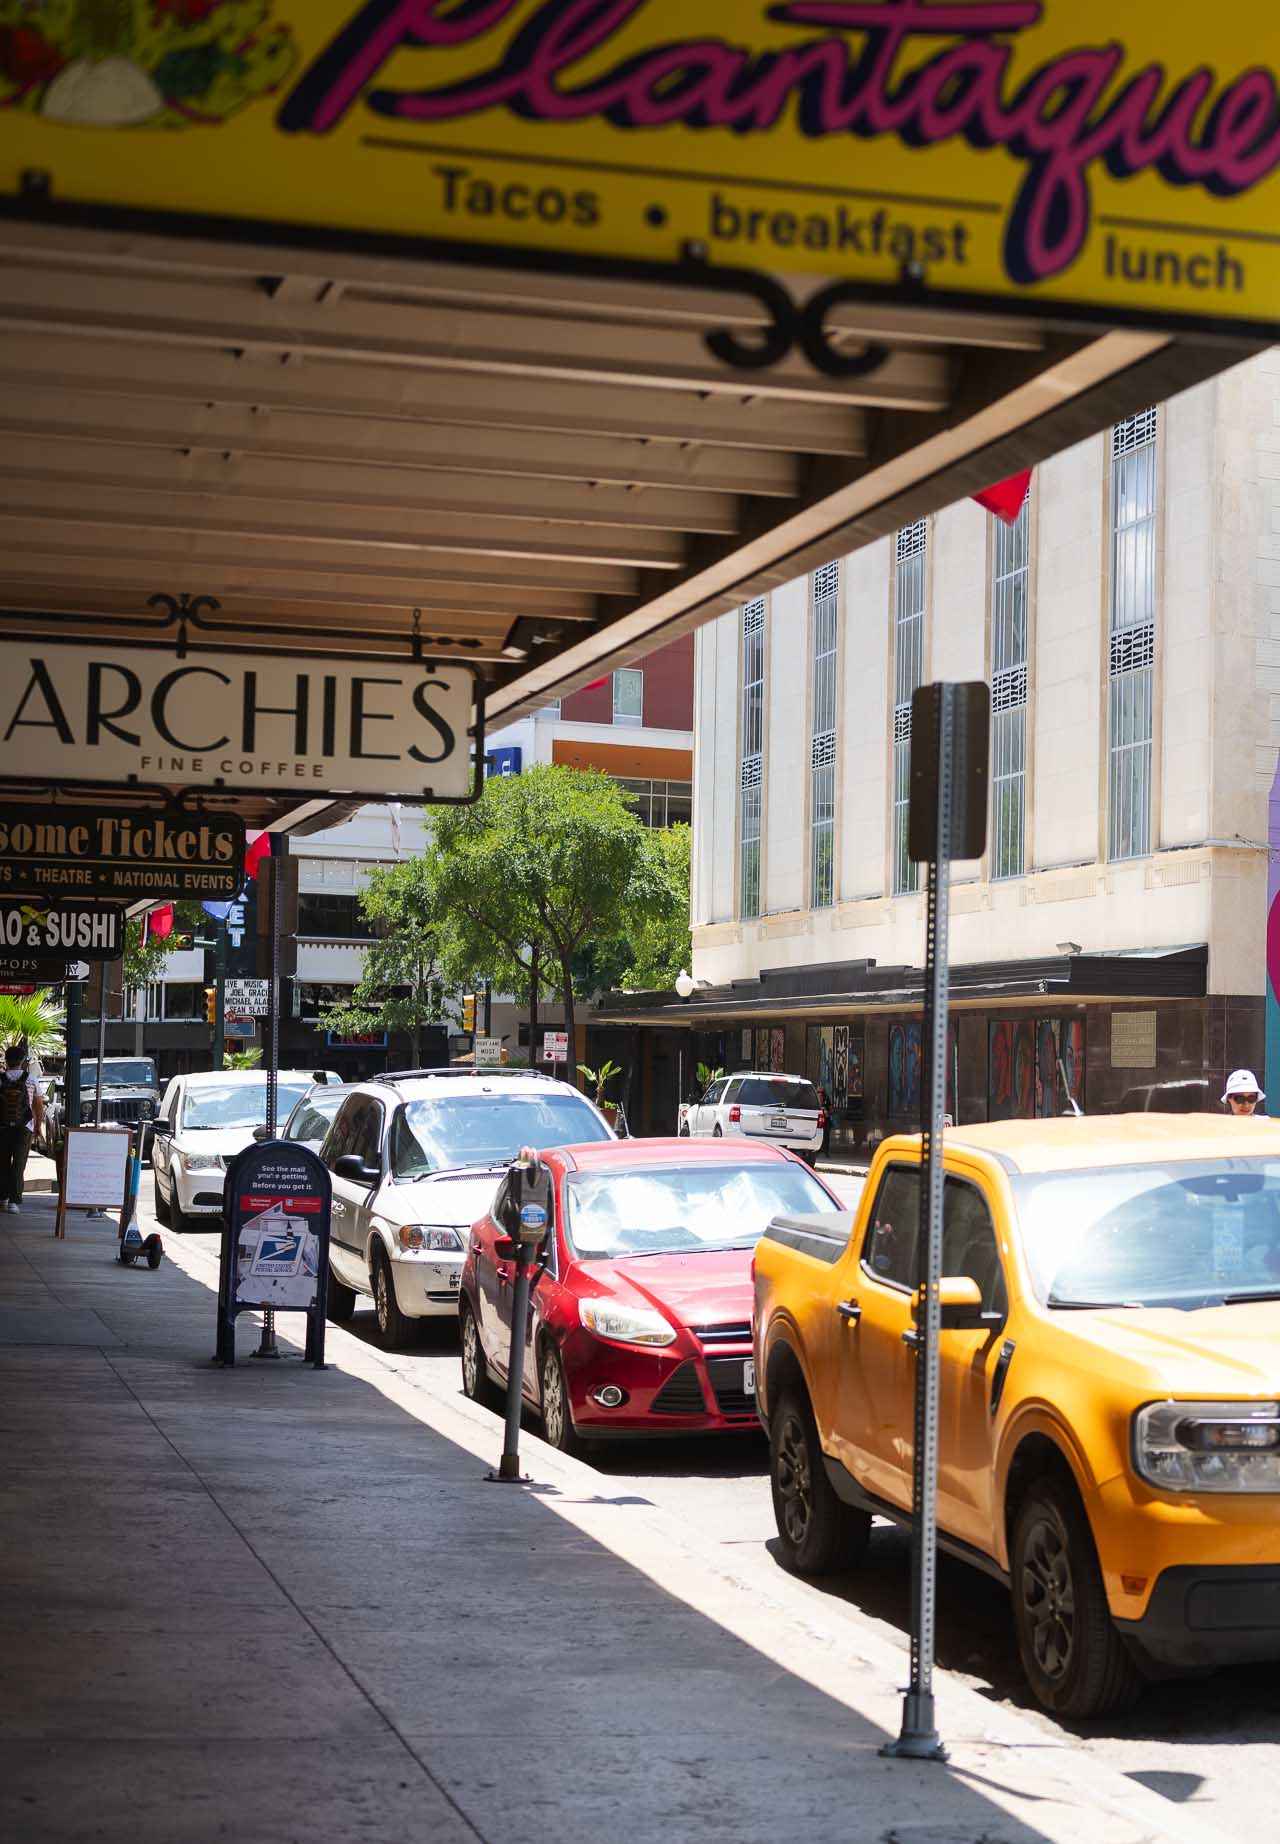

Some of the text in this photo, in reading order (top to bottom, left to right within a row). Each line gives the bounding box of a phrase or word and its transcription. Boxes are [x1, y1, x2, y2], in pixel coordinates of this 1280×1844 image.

[432, 166, 1246, 292] Tacos breakfast lunch
[3, 658, 456, 763] ARCHIES
[140, 755, 325, 778] FINE COFFEE
[96, 817, 233, 861] Tickets
[34, 867, 94, 885] THEATRE
[113, 871, 180, 889] NATIONAL
[184, 873, 234, 891] EVENTS
[27, 925, 41, 946] &
[45, 911, 116, 949] SUSHI
[225, 997, 252, 1005] MICHAEL
[230, 988, 245, 997] JOEL
